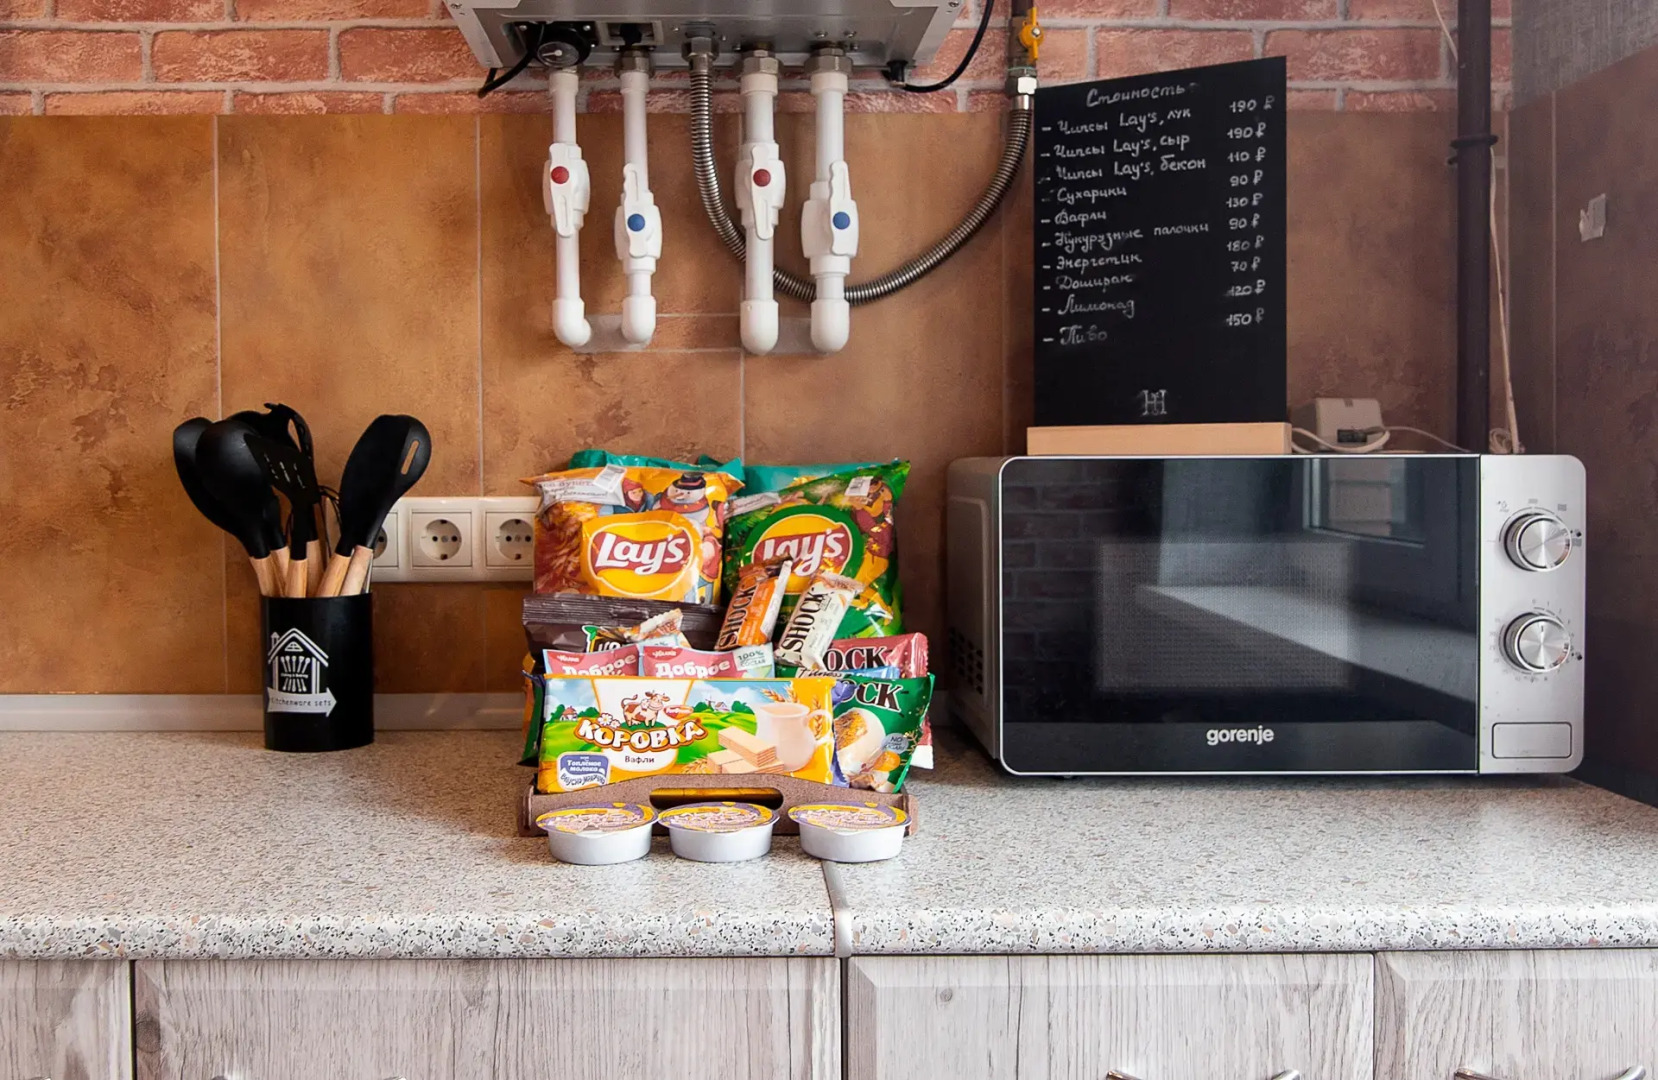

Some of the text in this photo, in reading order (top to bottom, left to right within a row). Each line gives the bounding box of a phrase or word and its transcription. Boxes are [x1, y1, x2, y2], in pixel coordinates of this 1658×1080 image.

[1057, 120, 1108, 135] Чипсы
[1167, 108, 1192, 120] лук
[1053, 144, 1106, 158] Чипсы
[1159, 134, 1190, 152] сыр
[1055, 164, 1103, 180] Чипсы
[1160, 154, 1206, 171] бекон
[1056, 187, 1128, 205] Сухарики
[1054, 209, 1107, 228] Вафли
[1153, 222, 1209, 236] палочки
[1056, 254, 1143, 276] Энергетик
[1057, 274, 1135, 294] Доширак
[1057, 294, 1135, 319] Лимонад
[595, 531, 687, 576] Lay's
[782, 588, 831, 655] SHOCK
[822, 646, 887, 672] OCK
[577, 718, 705, 749] КОРОВКА
[1206, 724, 1275, 746] gorenje
[624, 755, 655, 764] Вафли
